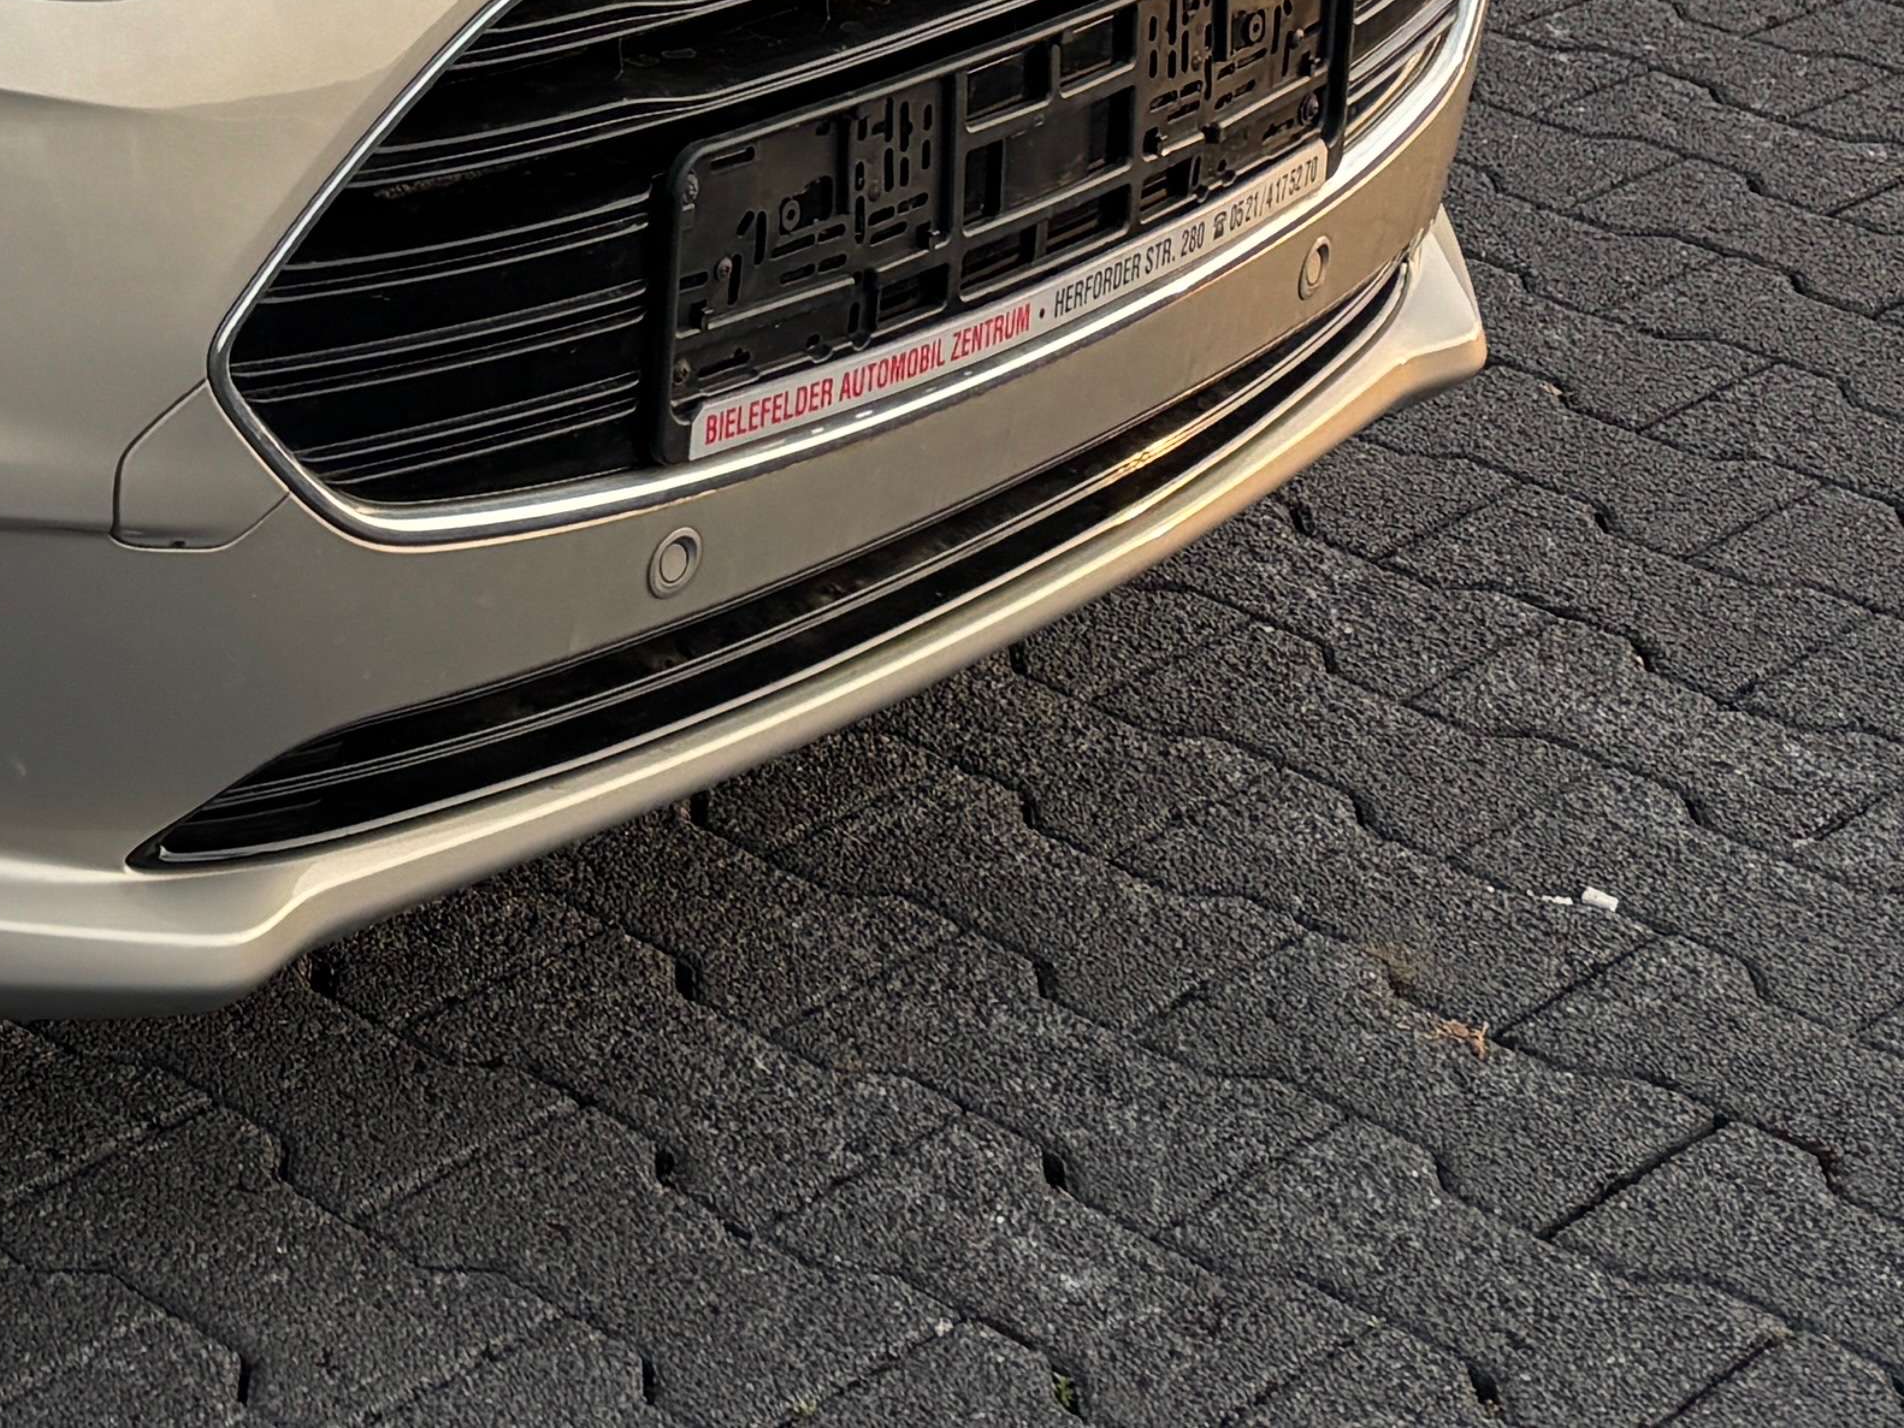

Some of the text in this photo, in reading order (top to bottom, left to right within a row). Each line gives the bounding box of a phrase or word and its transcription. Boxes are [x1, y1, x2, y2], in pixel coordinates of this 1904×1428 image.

[704, 378, 833, 445] BIELEFELDER
[839, 338, 946, 402] AUTOMOBIL
[950, 303, 1031, 361] ZENTRUM
[1054, 253, 1141, 318] HERFORDER
[1144, 238, 1176, 275] STR.
[1181, 221, 1206, 257] 280
